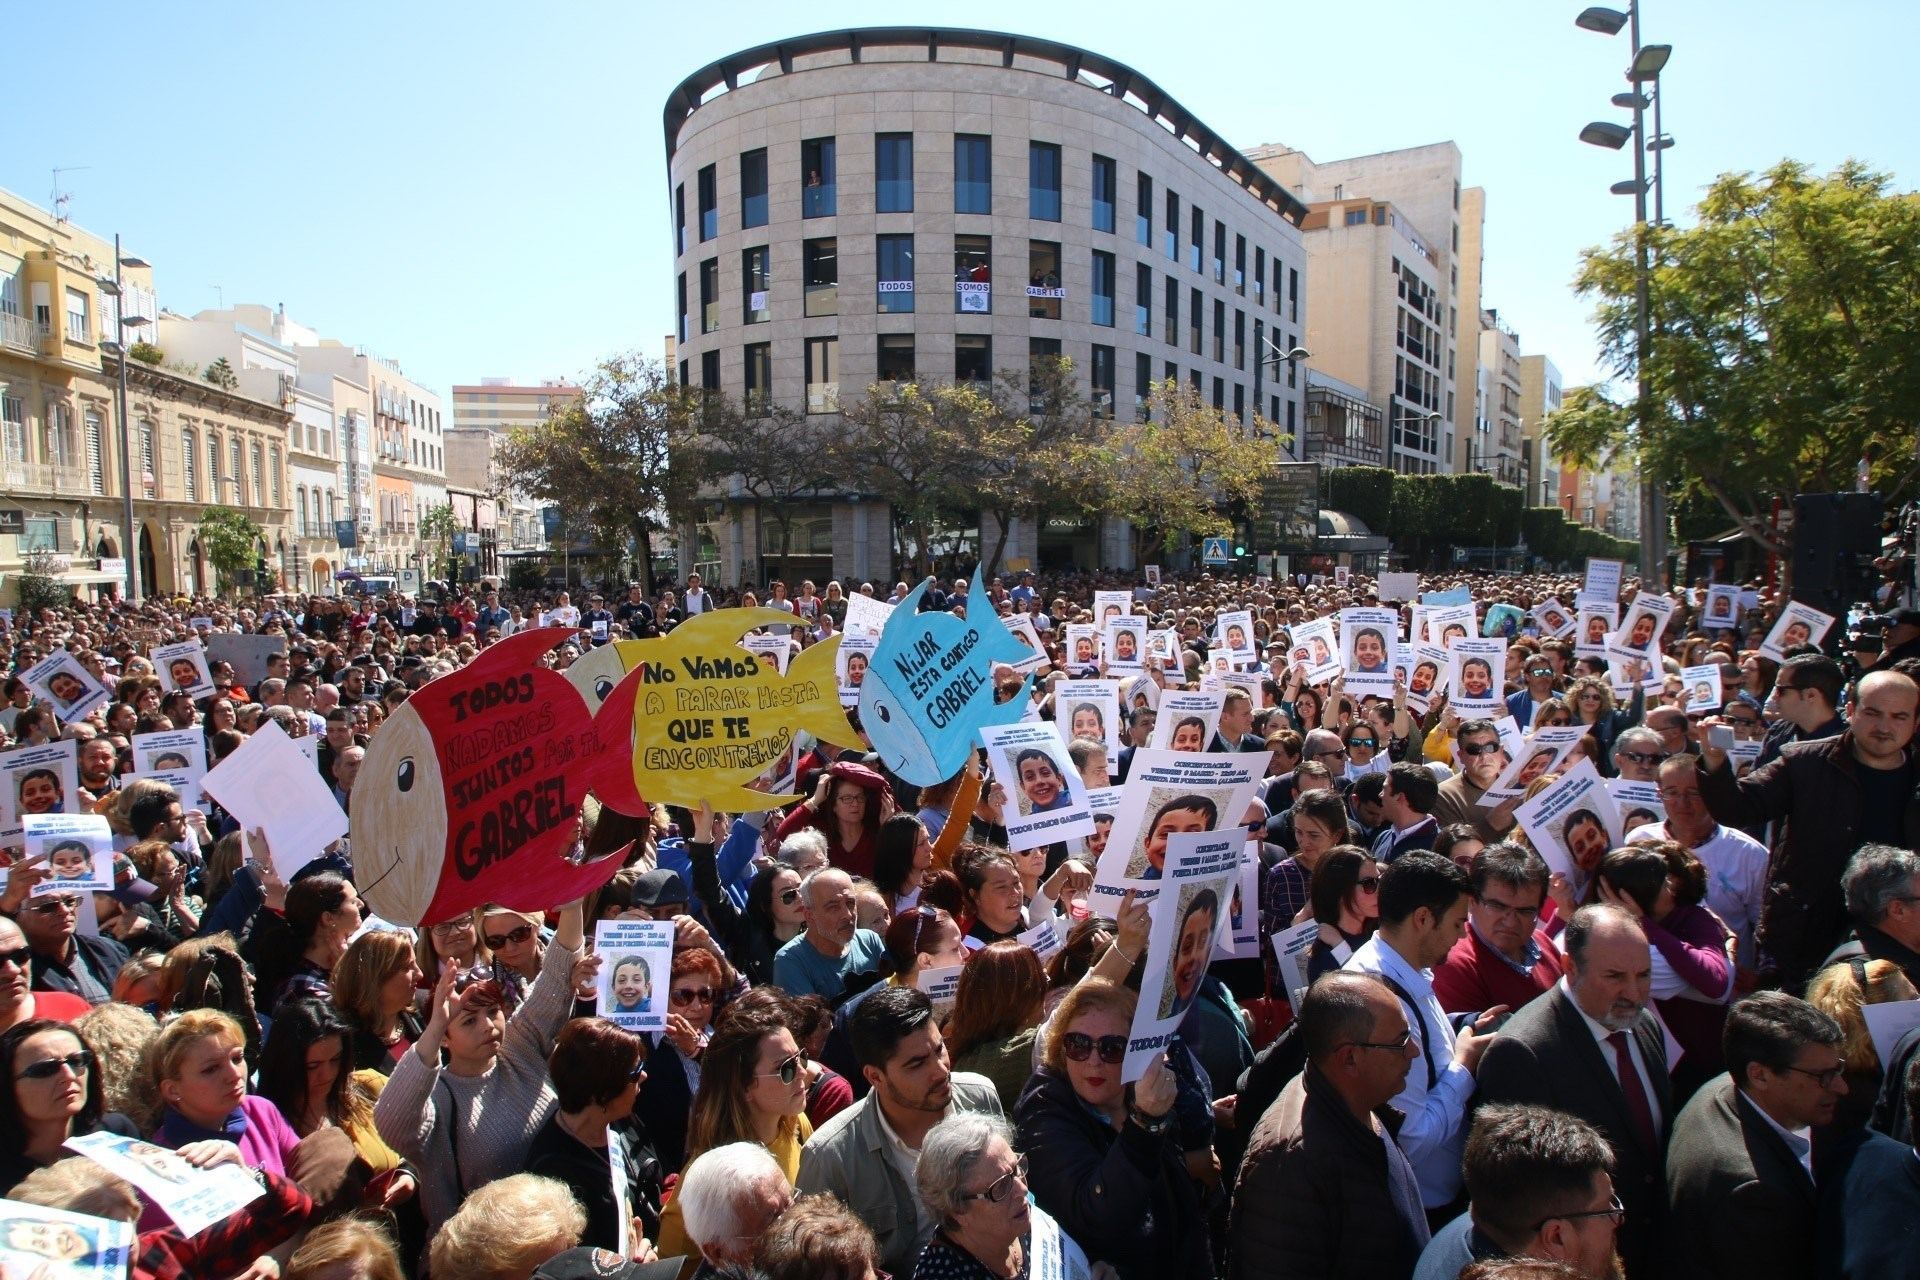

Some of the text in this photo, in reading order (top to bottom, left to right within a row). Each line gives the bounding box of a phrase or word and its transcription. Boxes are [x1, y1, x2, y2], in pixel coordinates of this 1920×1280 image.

[880, 282, 912, 291] TODOS
[957, 283, 989, 292] SOMOS
[1026, 287, 1065, 297] GABRIEL
[909, 628, 979, 701] ESTA CONTIGO
[450, 673, 534, 723] TODOS
[646, 680, 820, 715] A PARAR HASTA
[444, 703, 555, 775] NADAMOS
[667, 717, 750, 743] QUE TE
[645, 727, 790, 770] ENCONTREMOS
[452, 746, 534, 809] JUNTOS
[544, 735, 575, 768] POR
[1008, 824, 1033, 836] TODOS
[1033, 818, 1060, 830] SOMOS
[1130, 1035, 1163, 1052] TODOS
